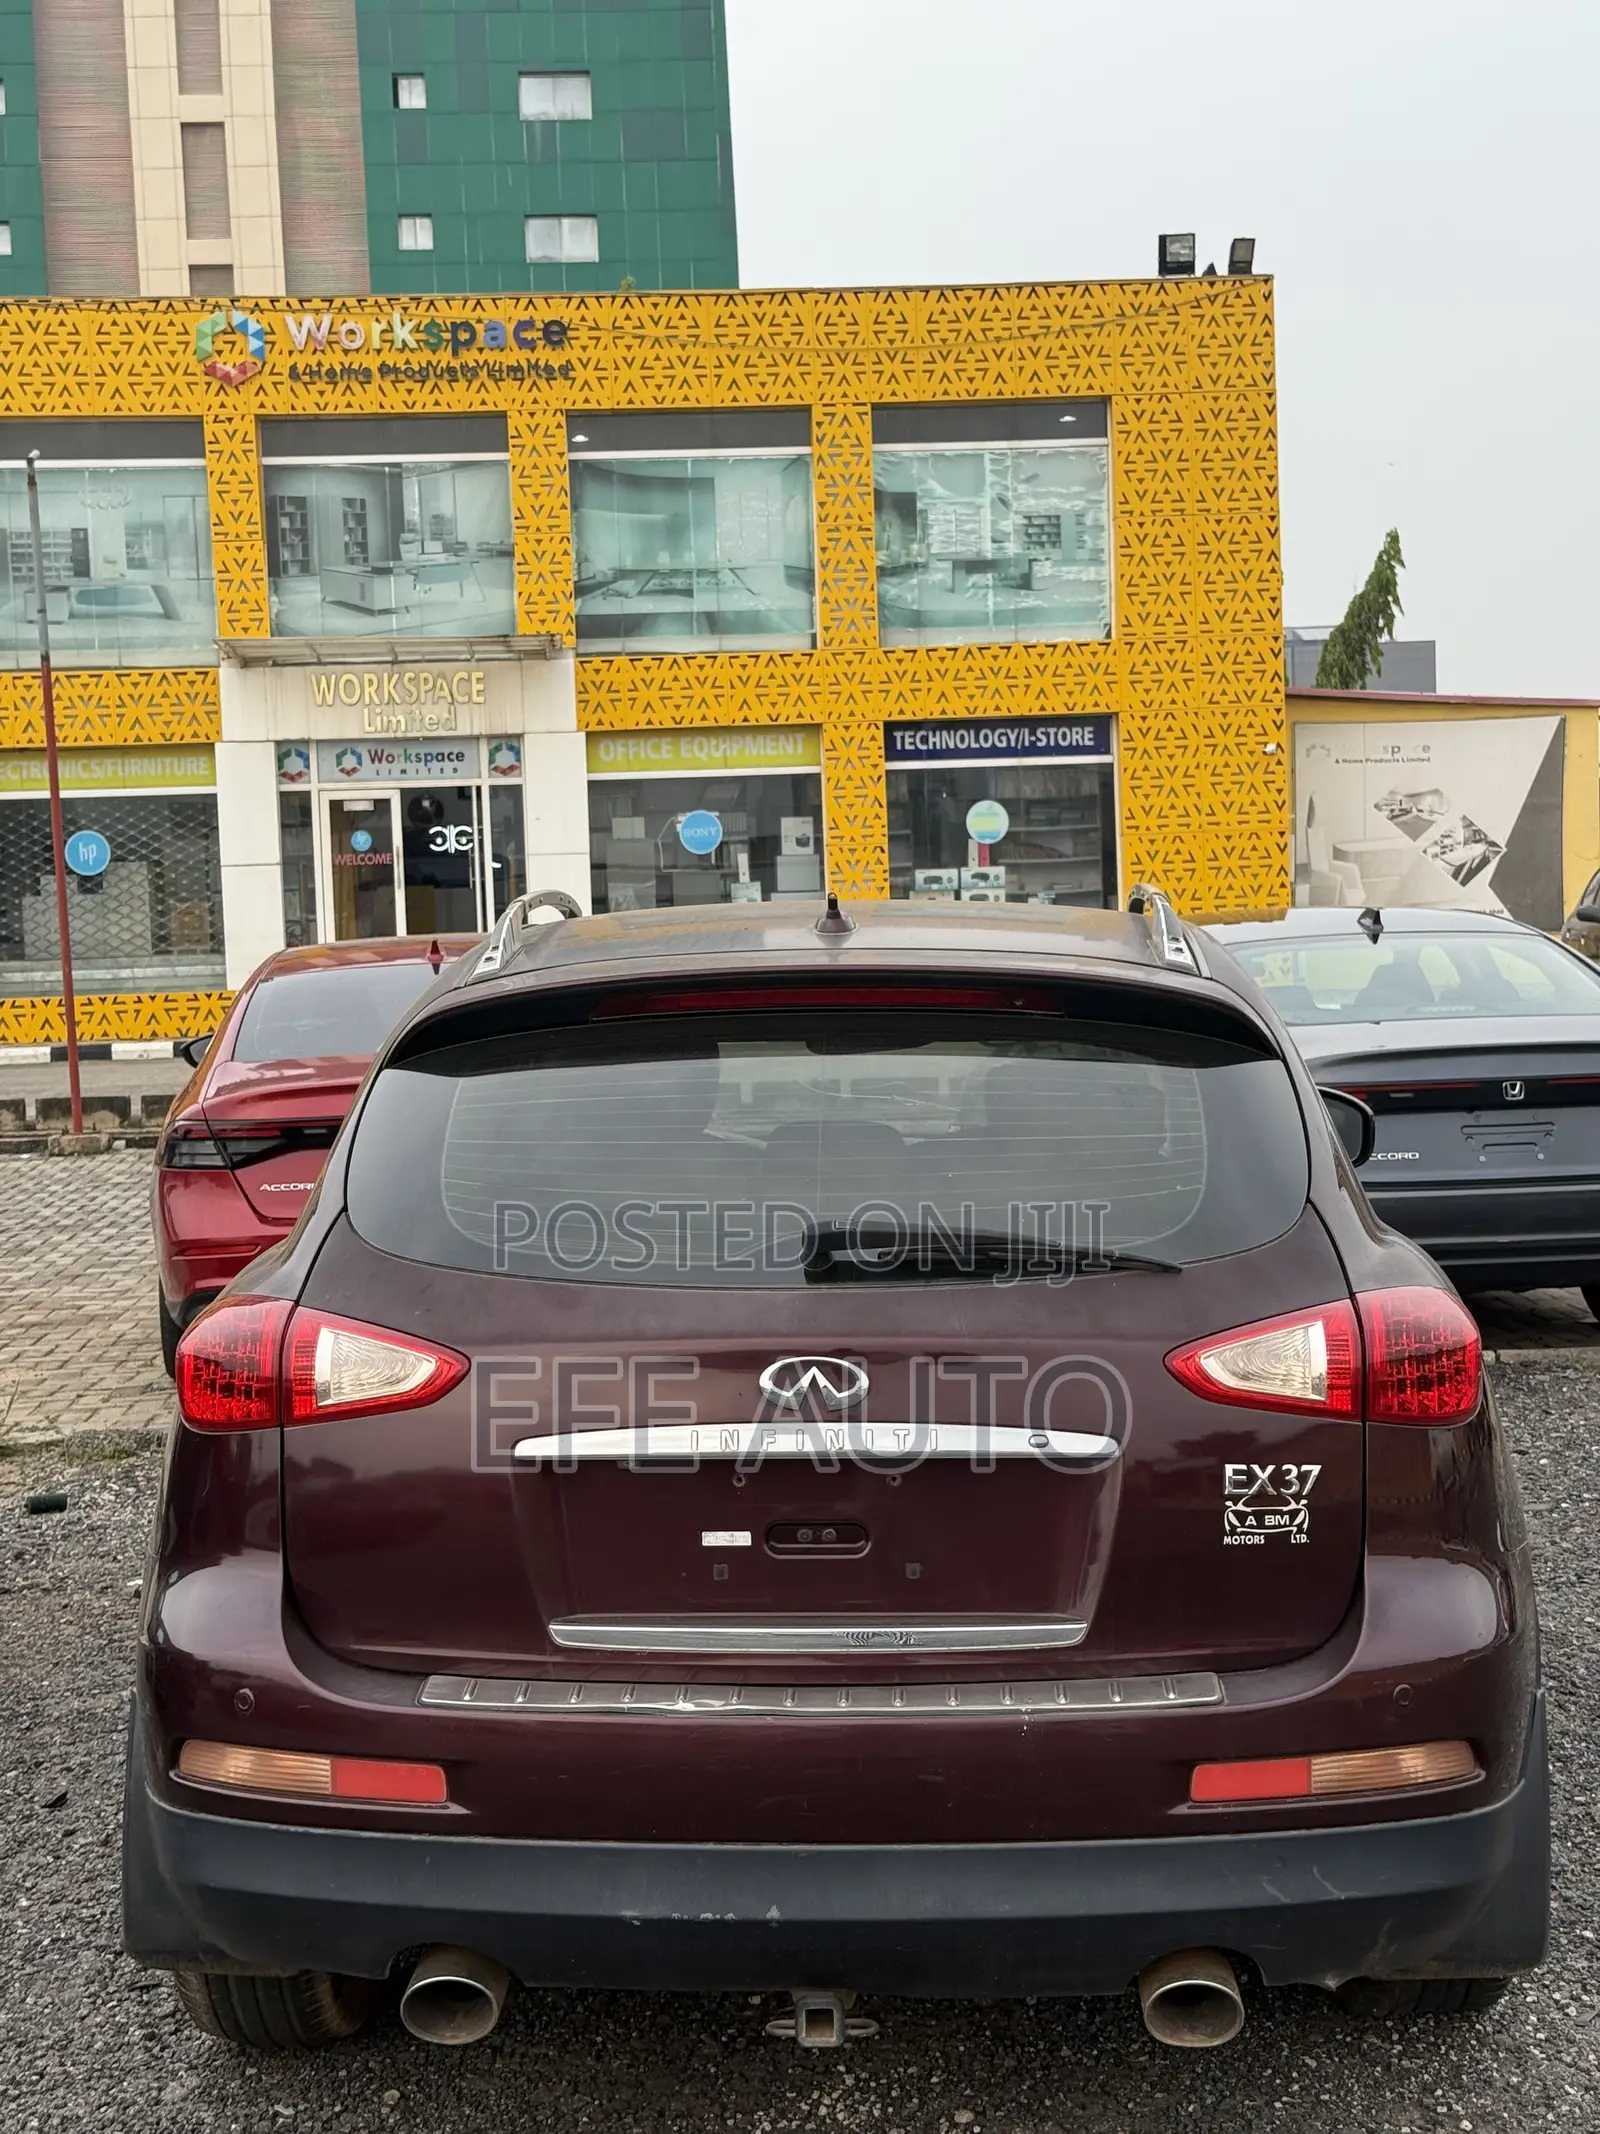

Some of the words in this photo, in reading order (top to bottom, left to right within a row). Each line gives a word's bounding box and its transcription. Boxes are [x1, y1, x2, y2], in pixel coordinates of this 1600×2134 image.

[285, 312, 569, 358] Workspace
[309, 364, 372, 381] Home
[377, 361, 479, 380] Products
[488, 359, 570, 379] Limited
[311, 671, 486, 707] WORKSPACE
[363, 708, 456, 733] Limited
[600, 737, 674, 762] OFFICE
[680, 732, 806, 759] EQUIPMENT
[893, 726, 1095, 750] TECHNOLOGY/I-STORE
[367, 748, 465, 767] Workspace
[375, 767, 459, 776] LIMITED
[684, 827, 717, 838] SONY
[78, 842, 97, 866] hp
[333, 853, 392, 866] WELCOME
[1369, 1151, 1420, 1161] CCORD
[690, 1428, 939, 1453] INFINITI
[1224, 1464, 1277, 1495] EX
[1280, 1464, 1322, 1495] 37
[1264, 1514, 1290, 1526] BM
[1223, 1534, 1265, 1545] MOTORS
[1290, 1534, 1310, 1544] LTD.
